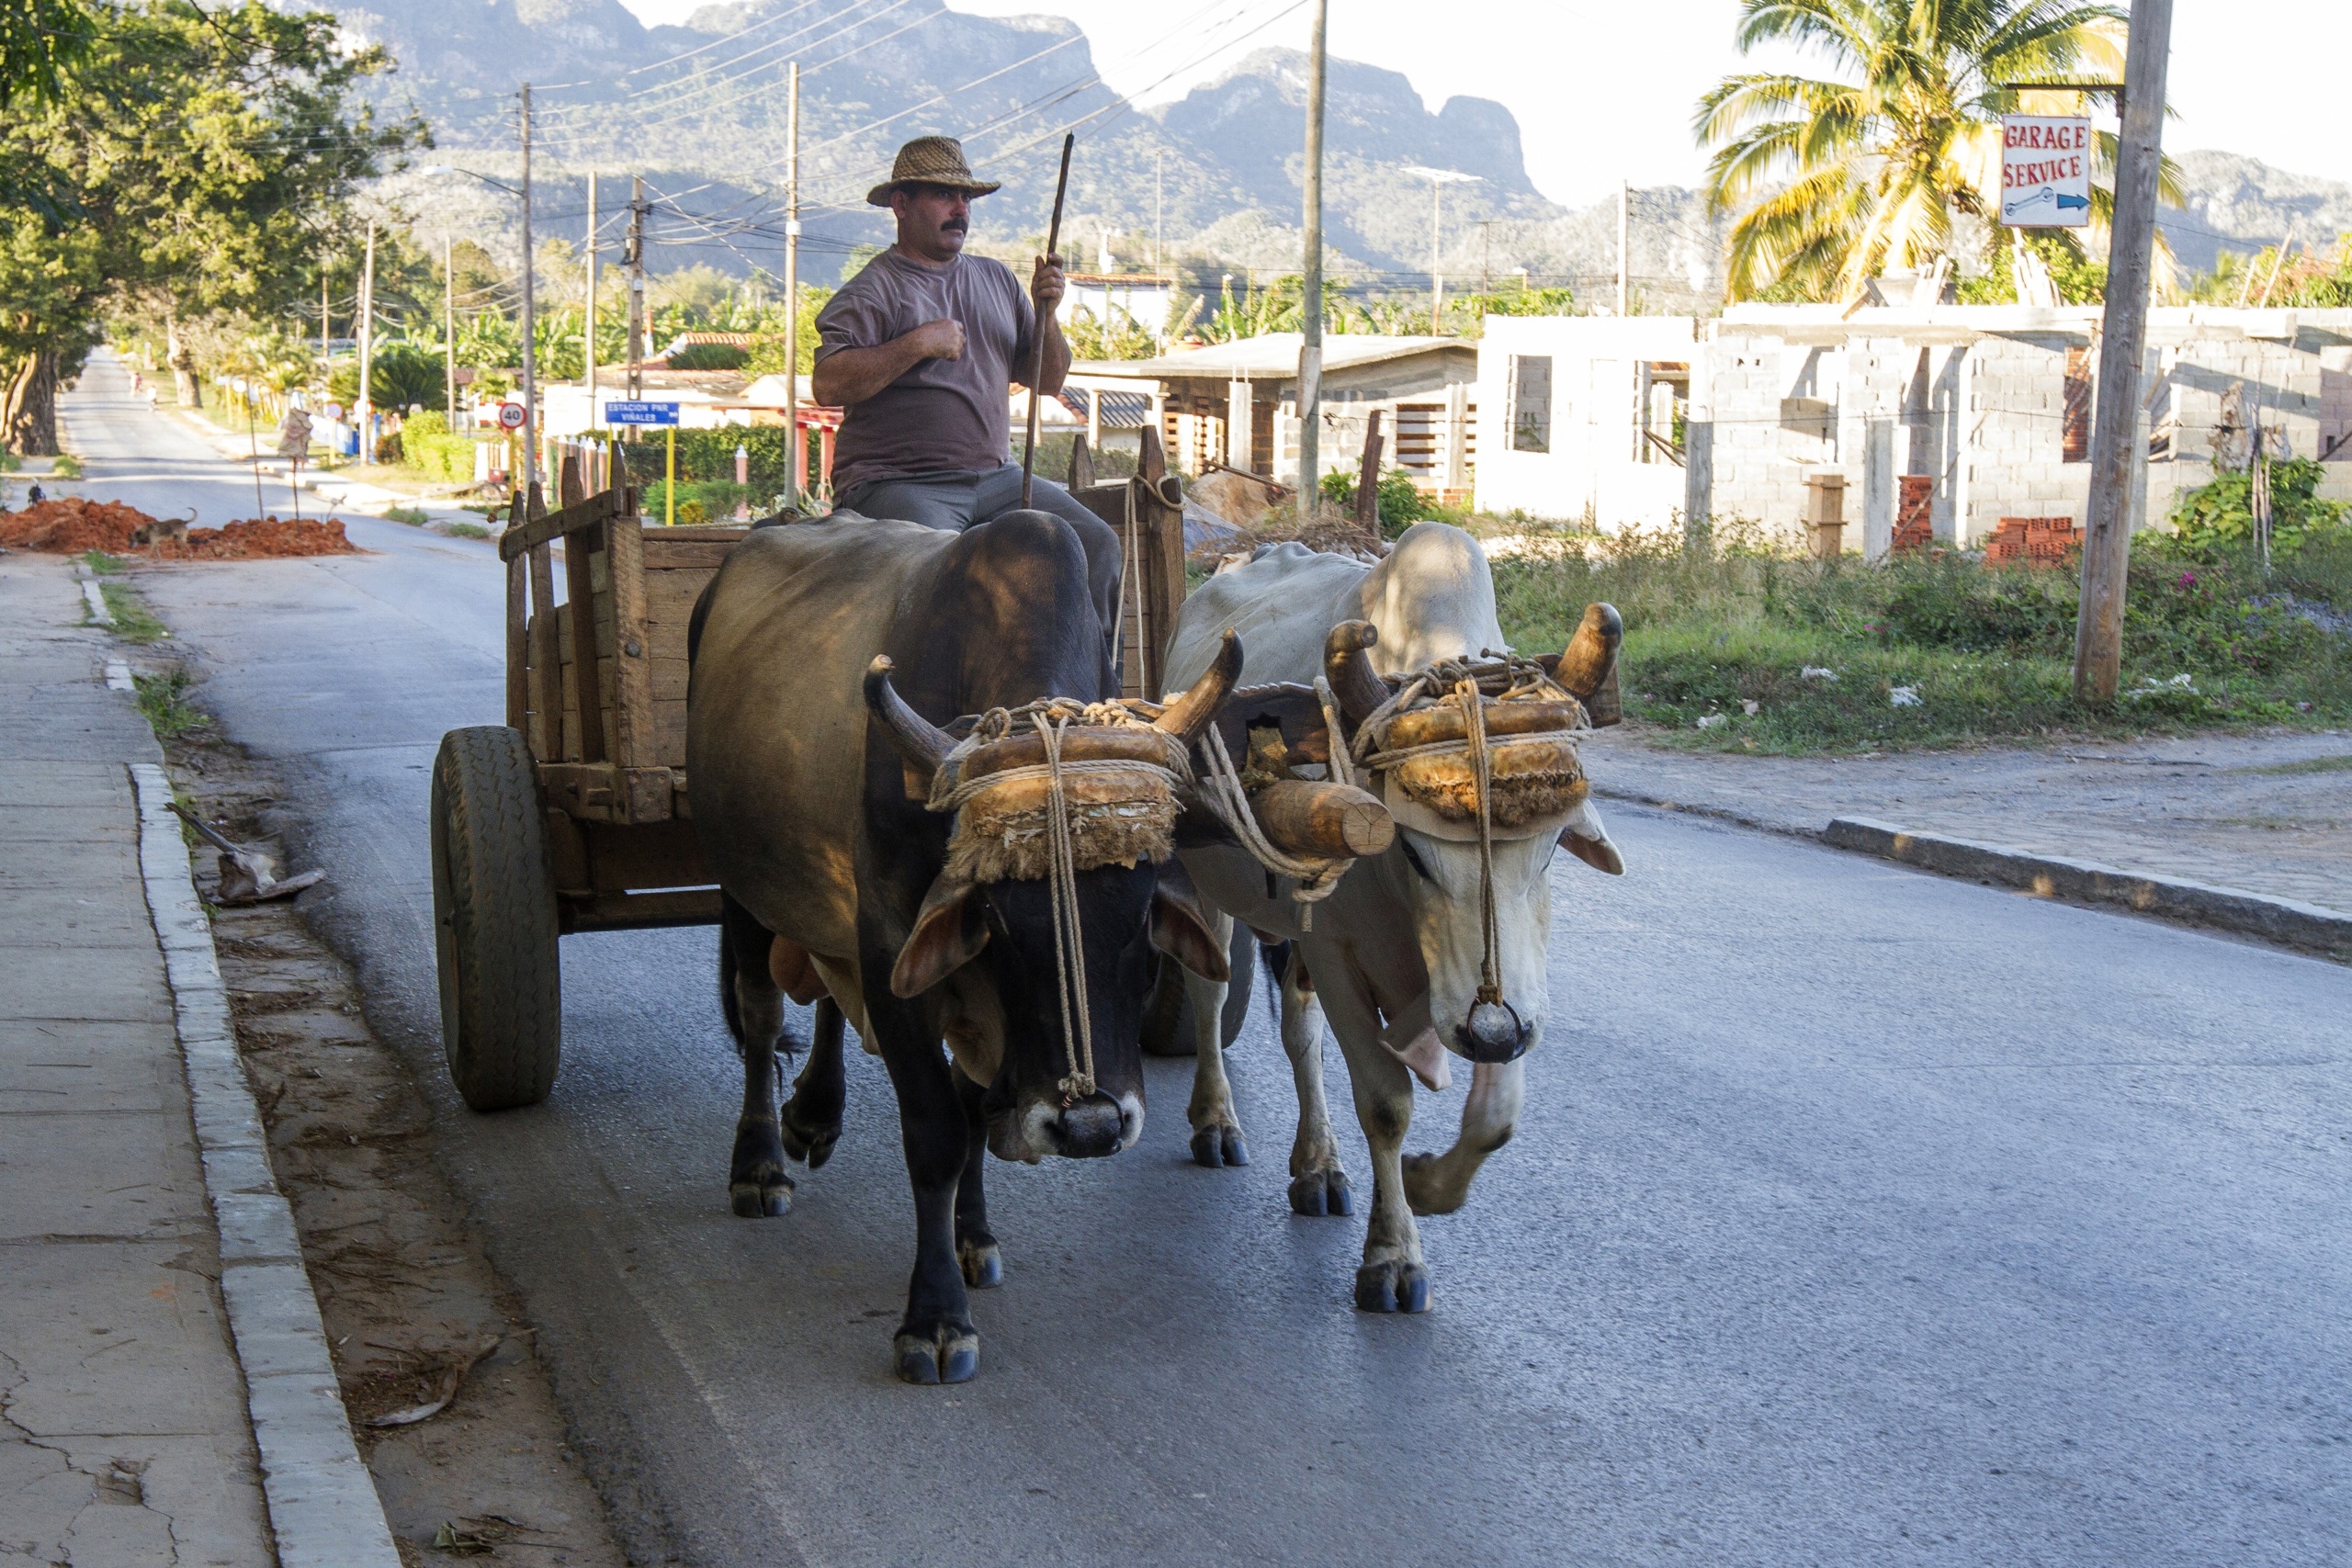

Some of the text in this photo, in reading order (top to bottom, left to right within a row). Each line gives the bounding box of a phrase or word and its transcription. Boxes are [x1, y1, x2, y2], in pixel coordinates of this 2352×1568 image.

[2005, 126, 2086, 150] GARAGE
[2003, 155, 2082, 188] SERVICE
[607, 402, 669, 412] ESTACION PNR
[503, 410, 520, 421] 40
[621, 412, 656, 423] VIÑALES
